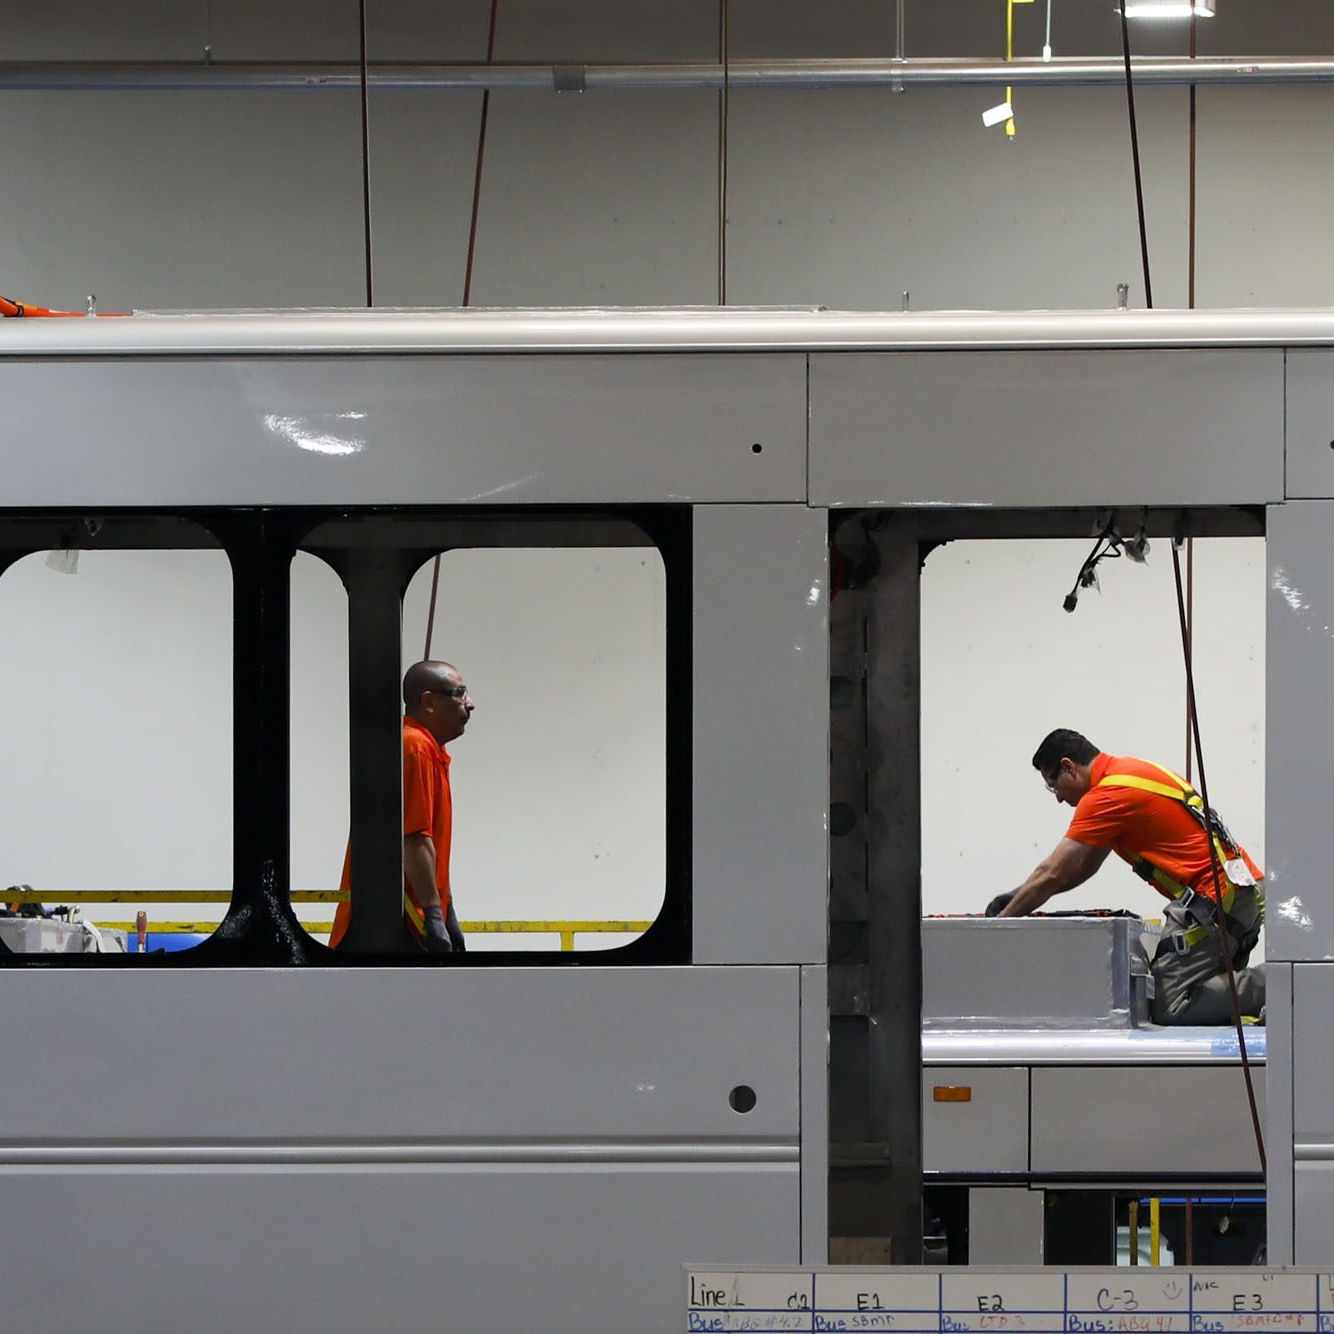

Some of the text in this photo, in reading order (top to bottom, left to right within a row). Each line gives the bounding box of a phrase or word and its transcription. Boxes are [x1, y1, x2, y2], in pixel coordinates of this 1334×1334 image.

[691, 1276, 726, 1307] Line
[787, 1292, 811, 1310] C1
[857, 1293, 885, 1310] E1
[1097, 1288, 1139, 1311] C-3
[977, 1295, 1005, 1312] E2
[1233, 1294, 1264, 1311] E3
[688, 1312, 723, 1331] Bus
[815, 1315, 846, 1331] Bus
[1069, 1314, 1114, 1331] Bus:
[1193, 1315, 1225, 1332] Bus
